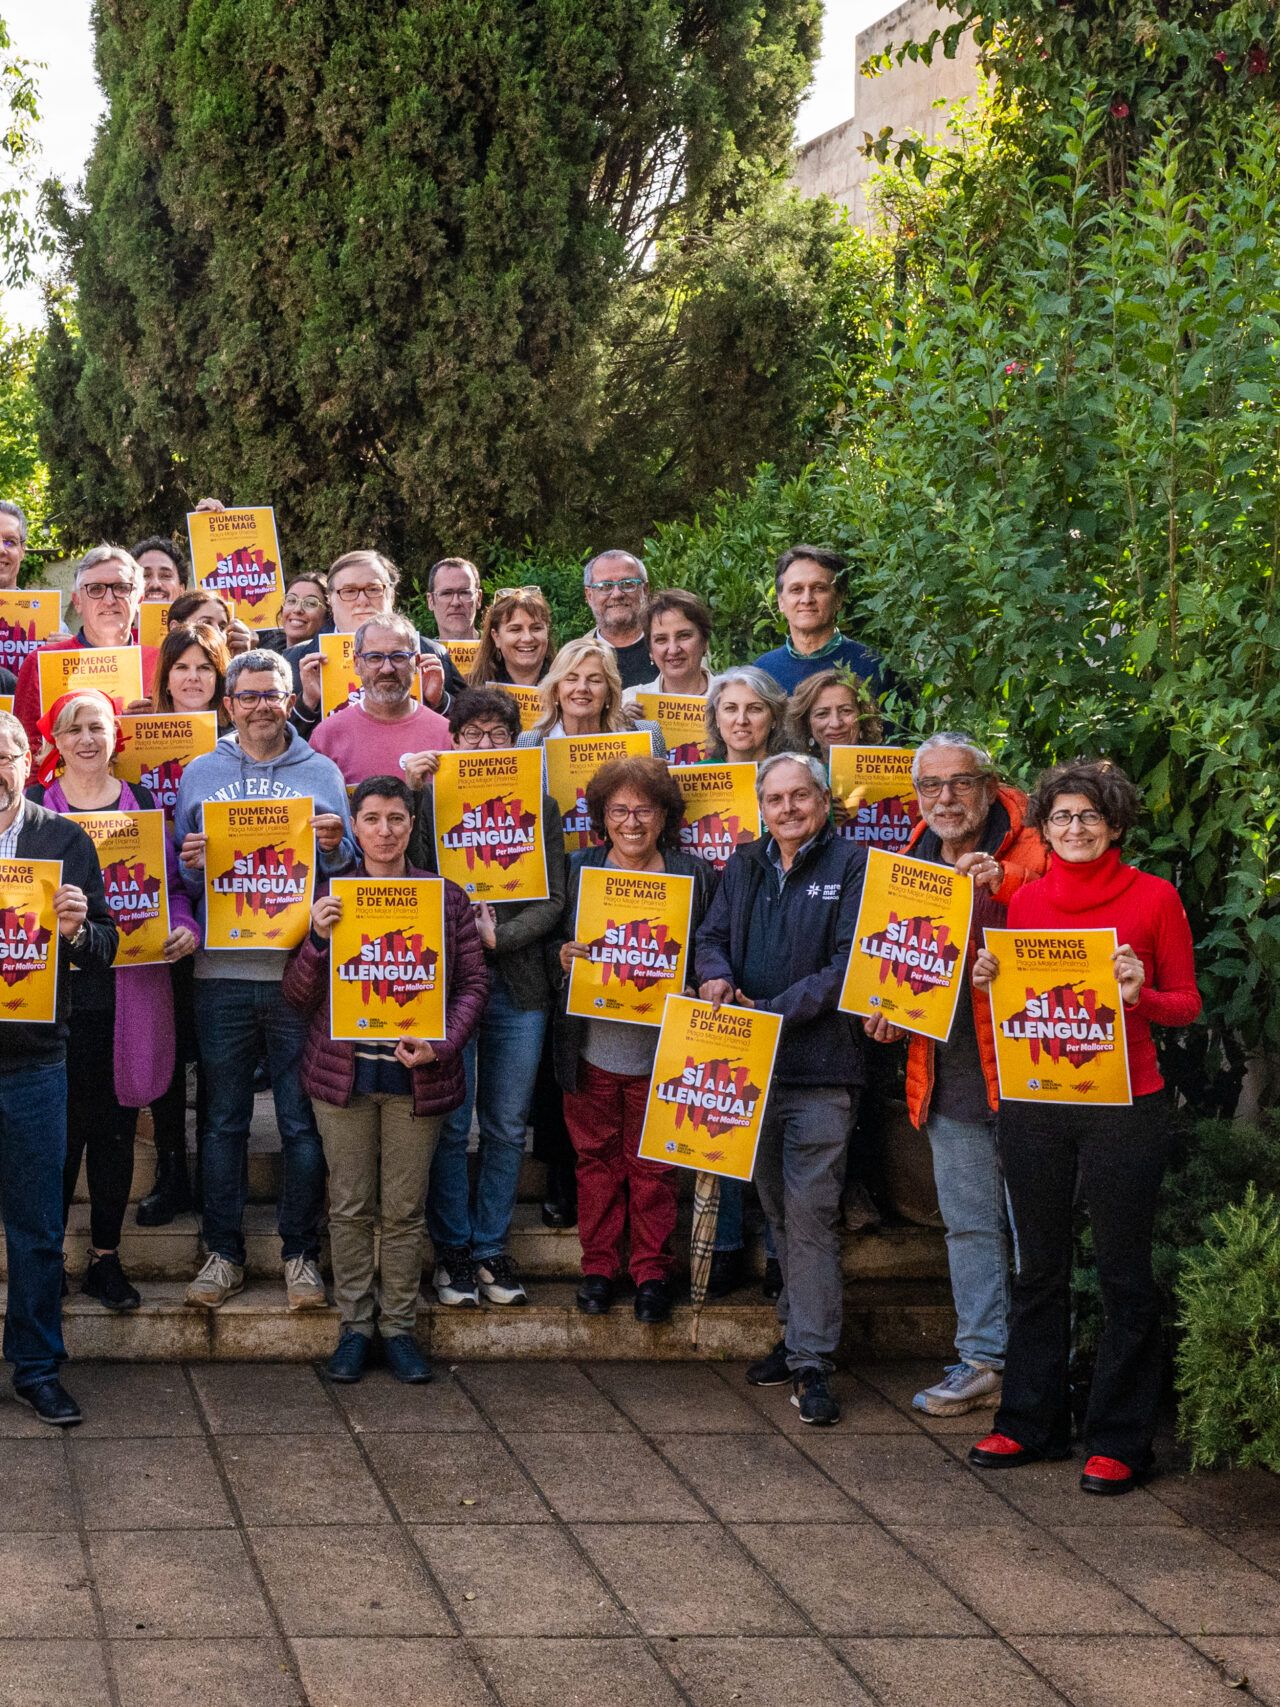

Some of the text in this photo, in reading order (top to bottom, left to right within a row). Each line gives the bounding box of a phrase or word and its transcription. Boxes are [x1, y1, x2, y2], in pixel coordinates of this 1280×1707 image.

[209, 514, 255, 523] DIUMENGE
[231, 521, 257, 530] MAIG
[217, 555, 260, 574] SÍ A LA
[202, 571, 277, 590] LLENGUA!
[63, 656, 116, 666] DIUMENGE
[63, 665, 118, 675] 5 DE MAIG
[570, 741, 626, 752] DIUMENGE
[459, 756, 516, 768] DIUMENGE
[459, 765, 517, 777] 5 DE MAIG
[230, 806, 287, 815] DIUMENGE
[463, 806, 516, 829] SÍ A LA
[230, 815, 288, 824] 5 DE MAIG
[443, 827, 535, 848] LLENGUA!
[234, 854, 287, 875] SÍ A LA
[0, 873, 33, 884] MAIG
[893, 863, 953, 886] DIUMENGE
[214, 877, 307, 893] LLENGUA!
[357, 887, 416, 896] DIUMENGE
[607, 877, 666, 890] DIUMENGE
[892, 873, 952, 896] 5 DE MAIG
[606, 886, 666, 900] 5 DE MAIG
[357, 897, 417, 906] 5 DE MAIG
[9, 929, 28, 940] LA
[605, 925, 659, 950] SÍ A LA
[886, 920, 938, 954] SÍ A LA
[360, 938, 415, 961] SÍ A LA
[1015, 938, 1085, 948] DIUMENGE
[588, 946, 677, 970] LENGUA!
[862, 937, 954, 978] LLENGUA!
[1016, 948, 1087, 959] 5 DE MAIG
[339, 964, 435, 980] LLENGUA!
[405, 983, 433, 991] Mallorca
[1025, 993, 1090, 1019] SÍ A LA
[691, 1009, 753, 1028] DIUMENGE
[689, 1019, 752, 1038] 5 DE MAIG
[1002, 1020, 1116, 1041] LLENGUA!
[1067, 1043, 1114, 1052] Per Mallorca
[682, 1063, 736, 1095] SÍ A LA
[656, 1082, 756, 1118] LLENGUA!
